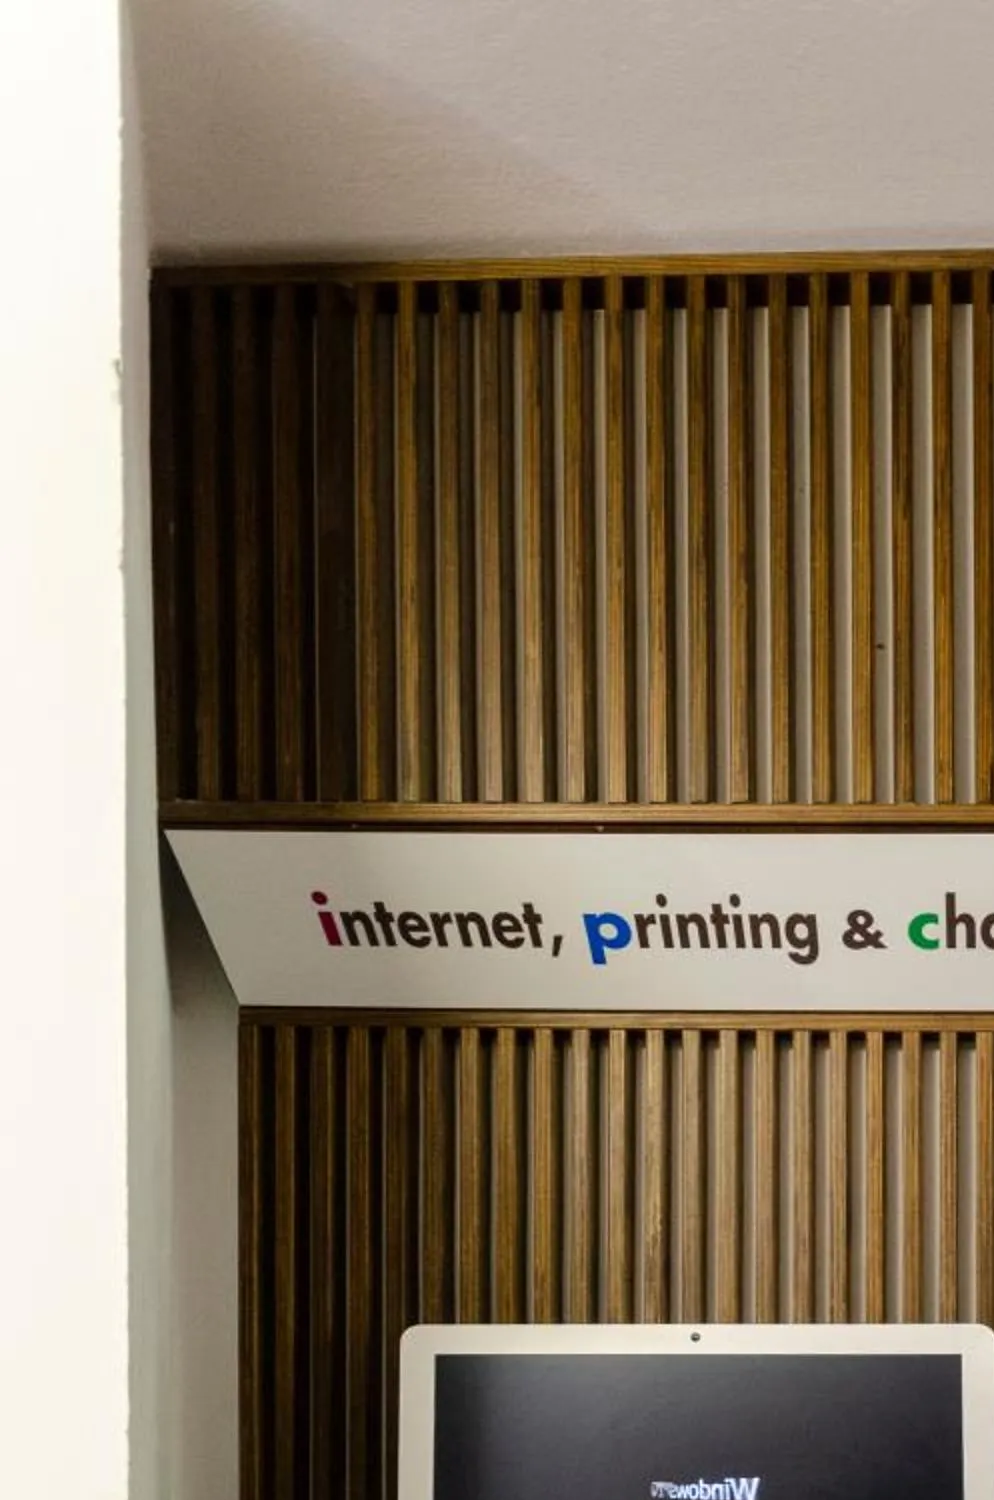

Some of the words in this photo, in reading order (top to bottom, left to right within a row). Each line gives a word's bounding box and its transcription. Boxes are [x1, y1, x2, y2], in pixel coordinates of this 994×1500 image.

[308, 888, 564, 958] internet,
[582, 892, 820, 966] printing
[842, 909, 887, 950] &
